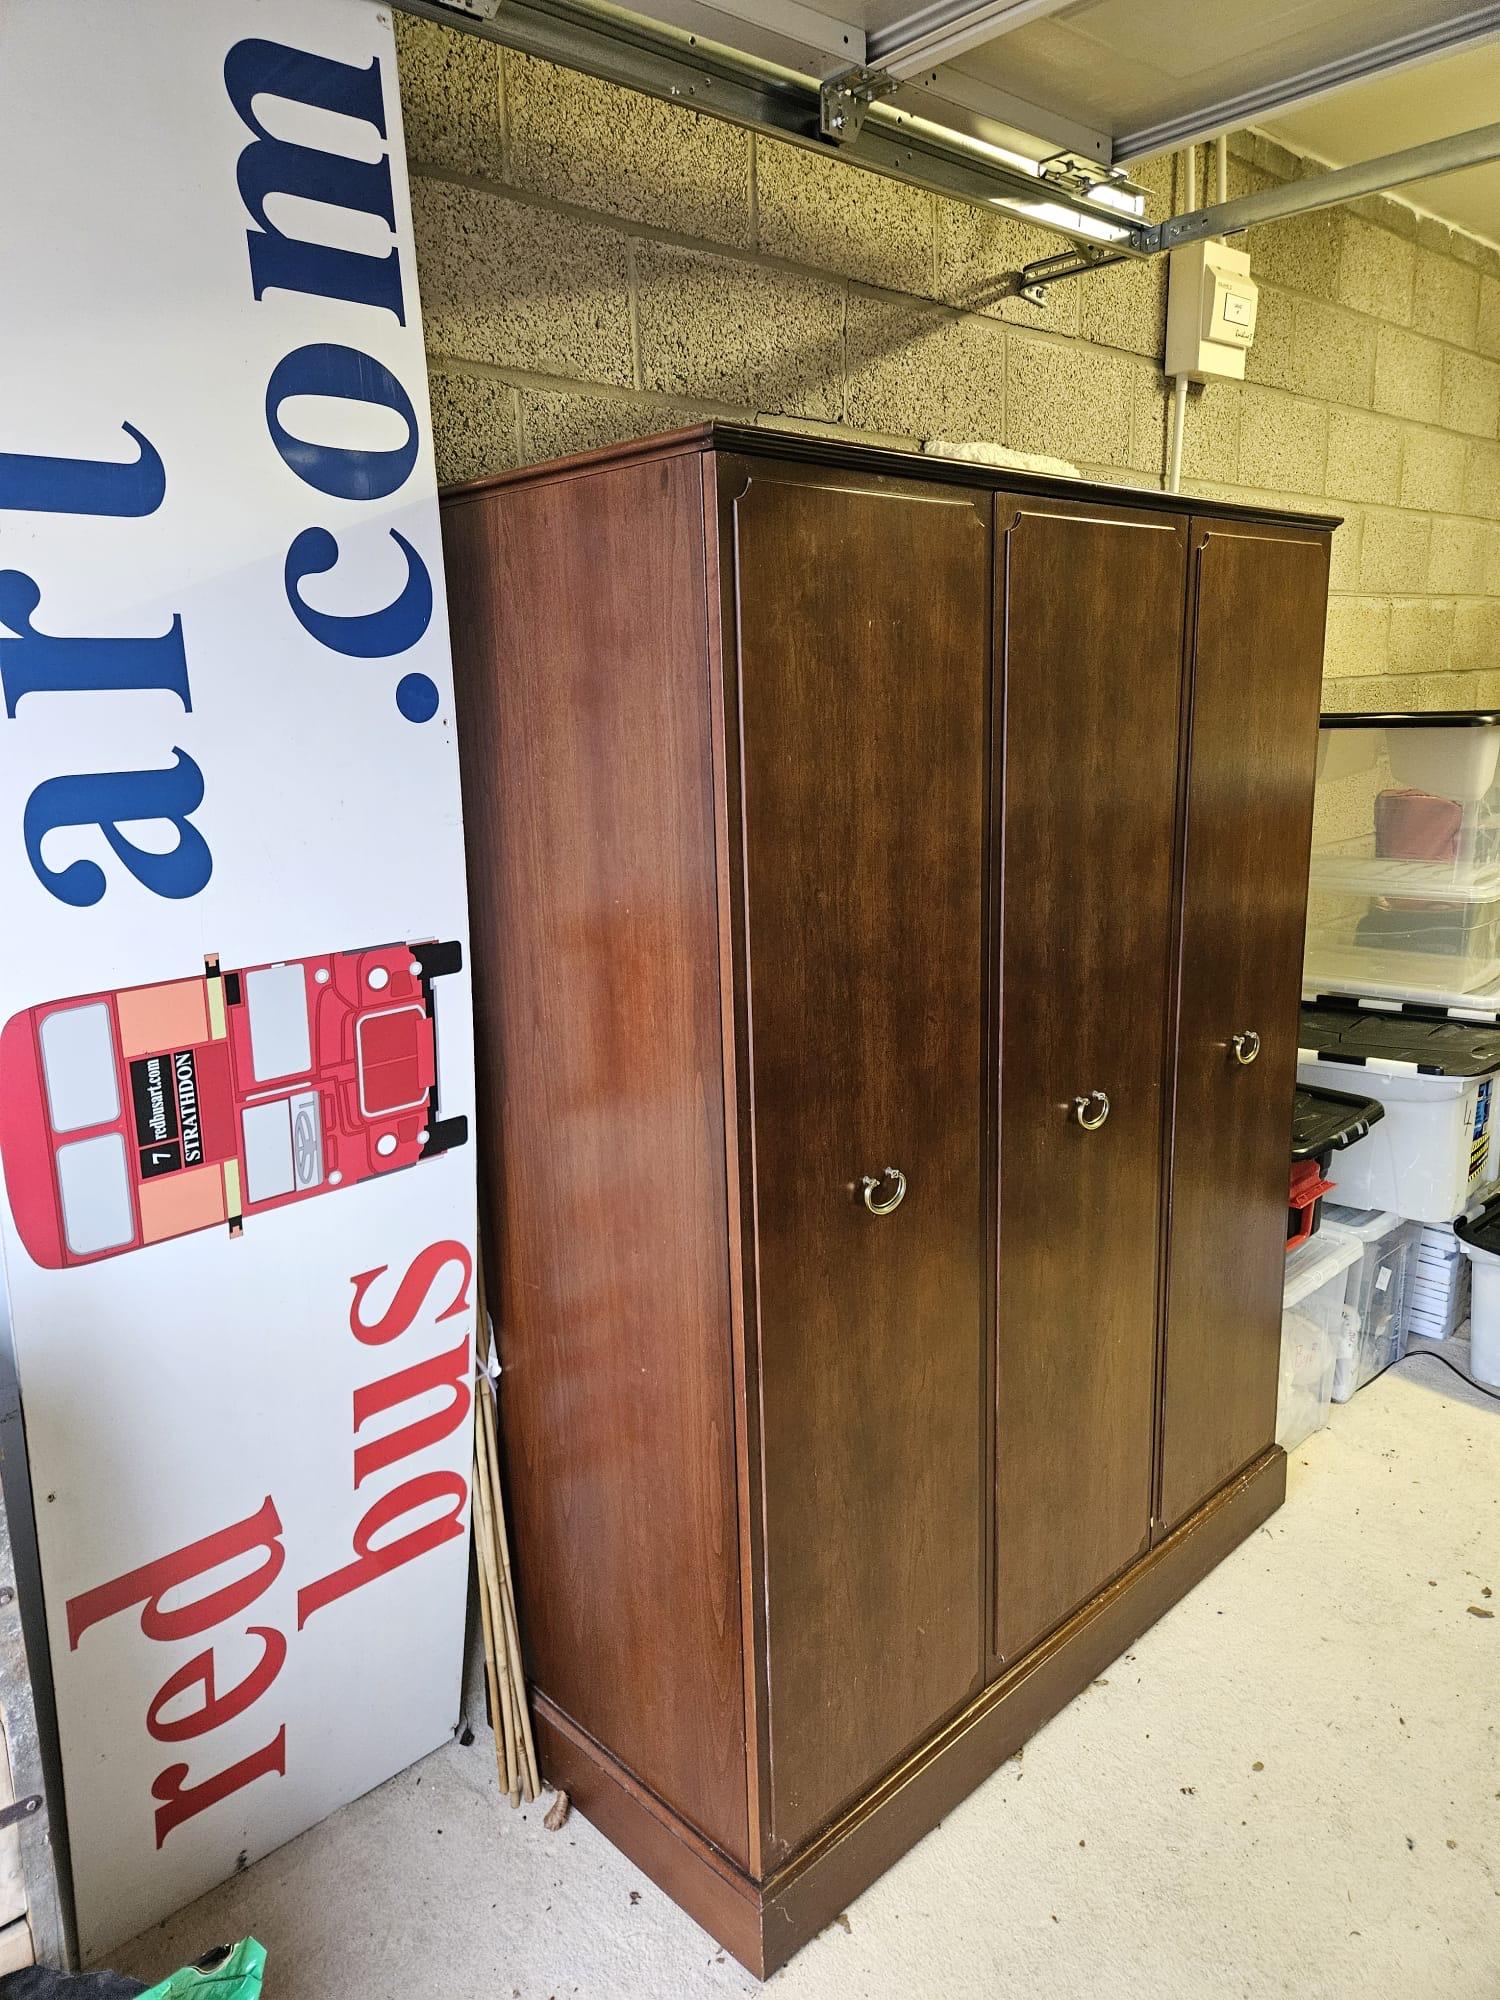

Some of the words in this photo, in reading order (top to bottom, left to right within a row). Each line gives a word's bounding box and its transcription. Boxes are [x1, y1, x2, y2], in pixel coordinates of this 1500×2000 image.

[224, 37, 440, 724] .com
[147, 1058, 168, 1141] redbusart.com
[152, 1152, 172, 1165] 7
[175, 1052, 201, 1162] STRATHDON
[297, 1239, 473, 1630] bus
[66, 1494, 288, 1850] red
